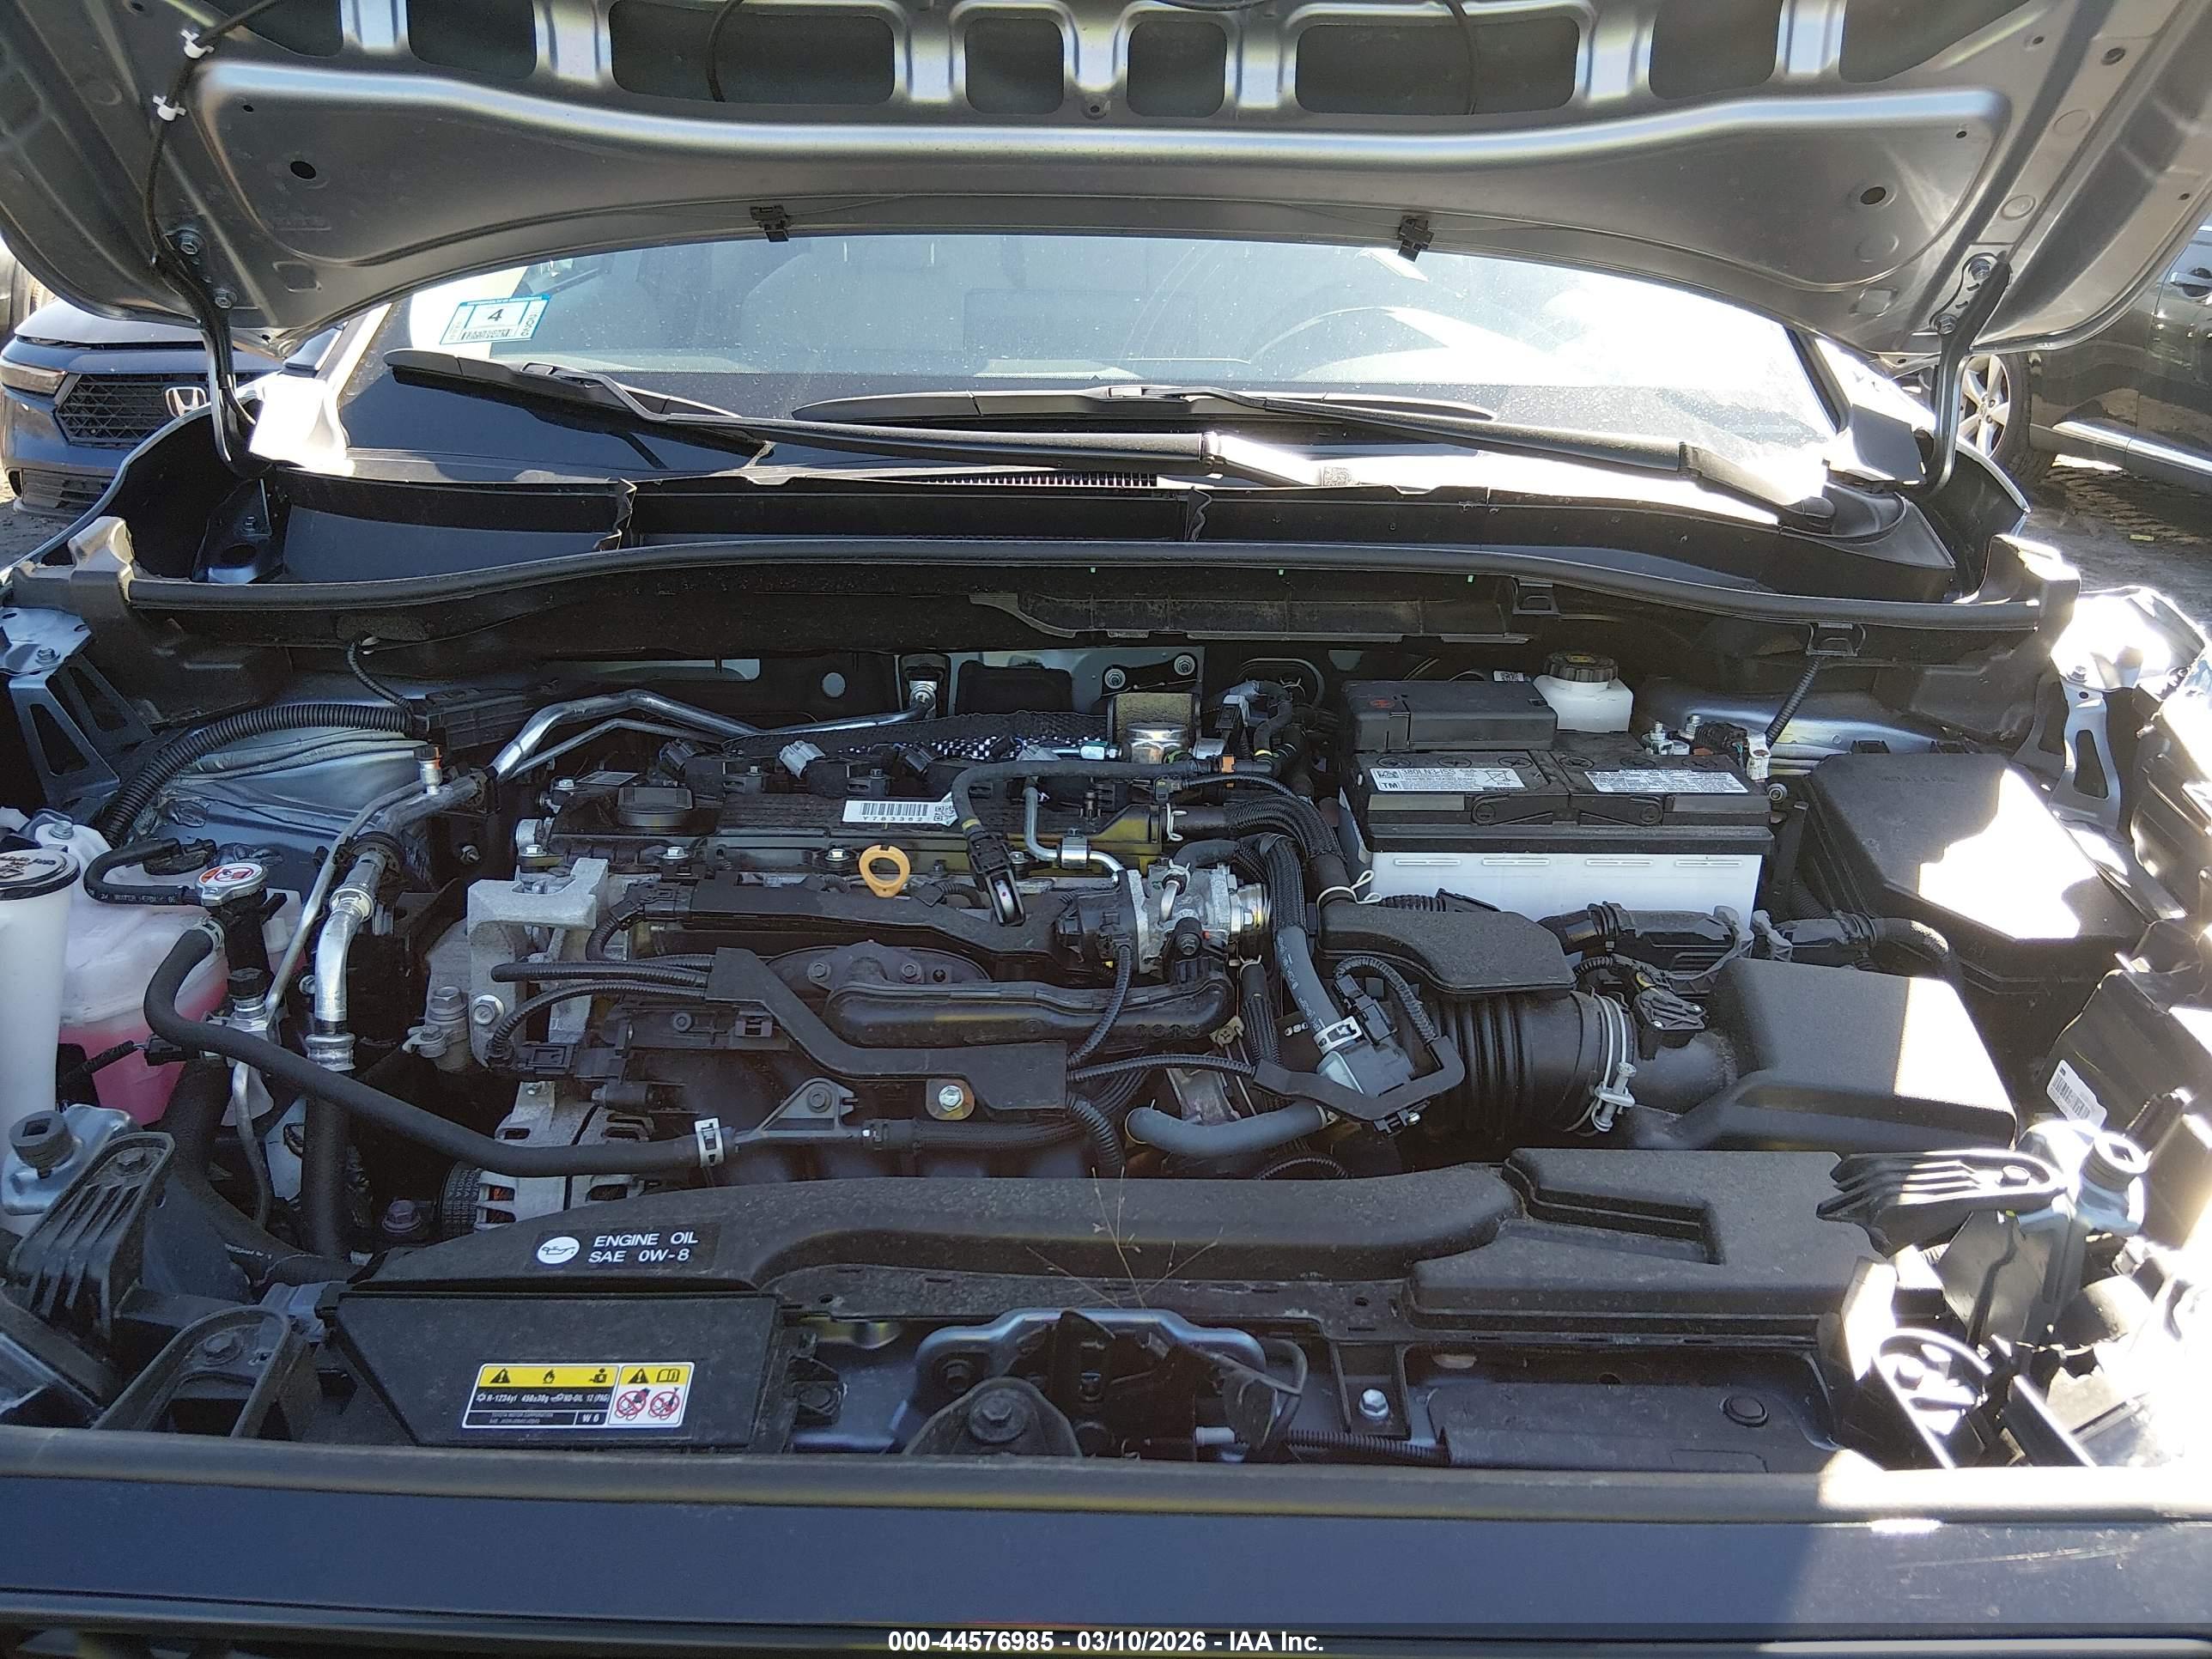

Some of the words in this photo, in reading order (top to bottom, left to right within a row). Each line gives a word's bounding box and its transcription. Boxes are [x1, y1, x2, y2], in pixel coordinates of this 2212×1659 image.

[488, 308, 504, 322] 4
[593, 1232, 660, 1247] ENGINE
[670, 1231, 699, 1244] OIL
[588, 1250, 628, 1263] SAE
[638, 1248, 690, 1262] 0W-8
[582, 1413, 592, 1424] W
